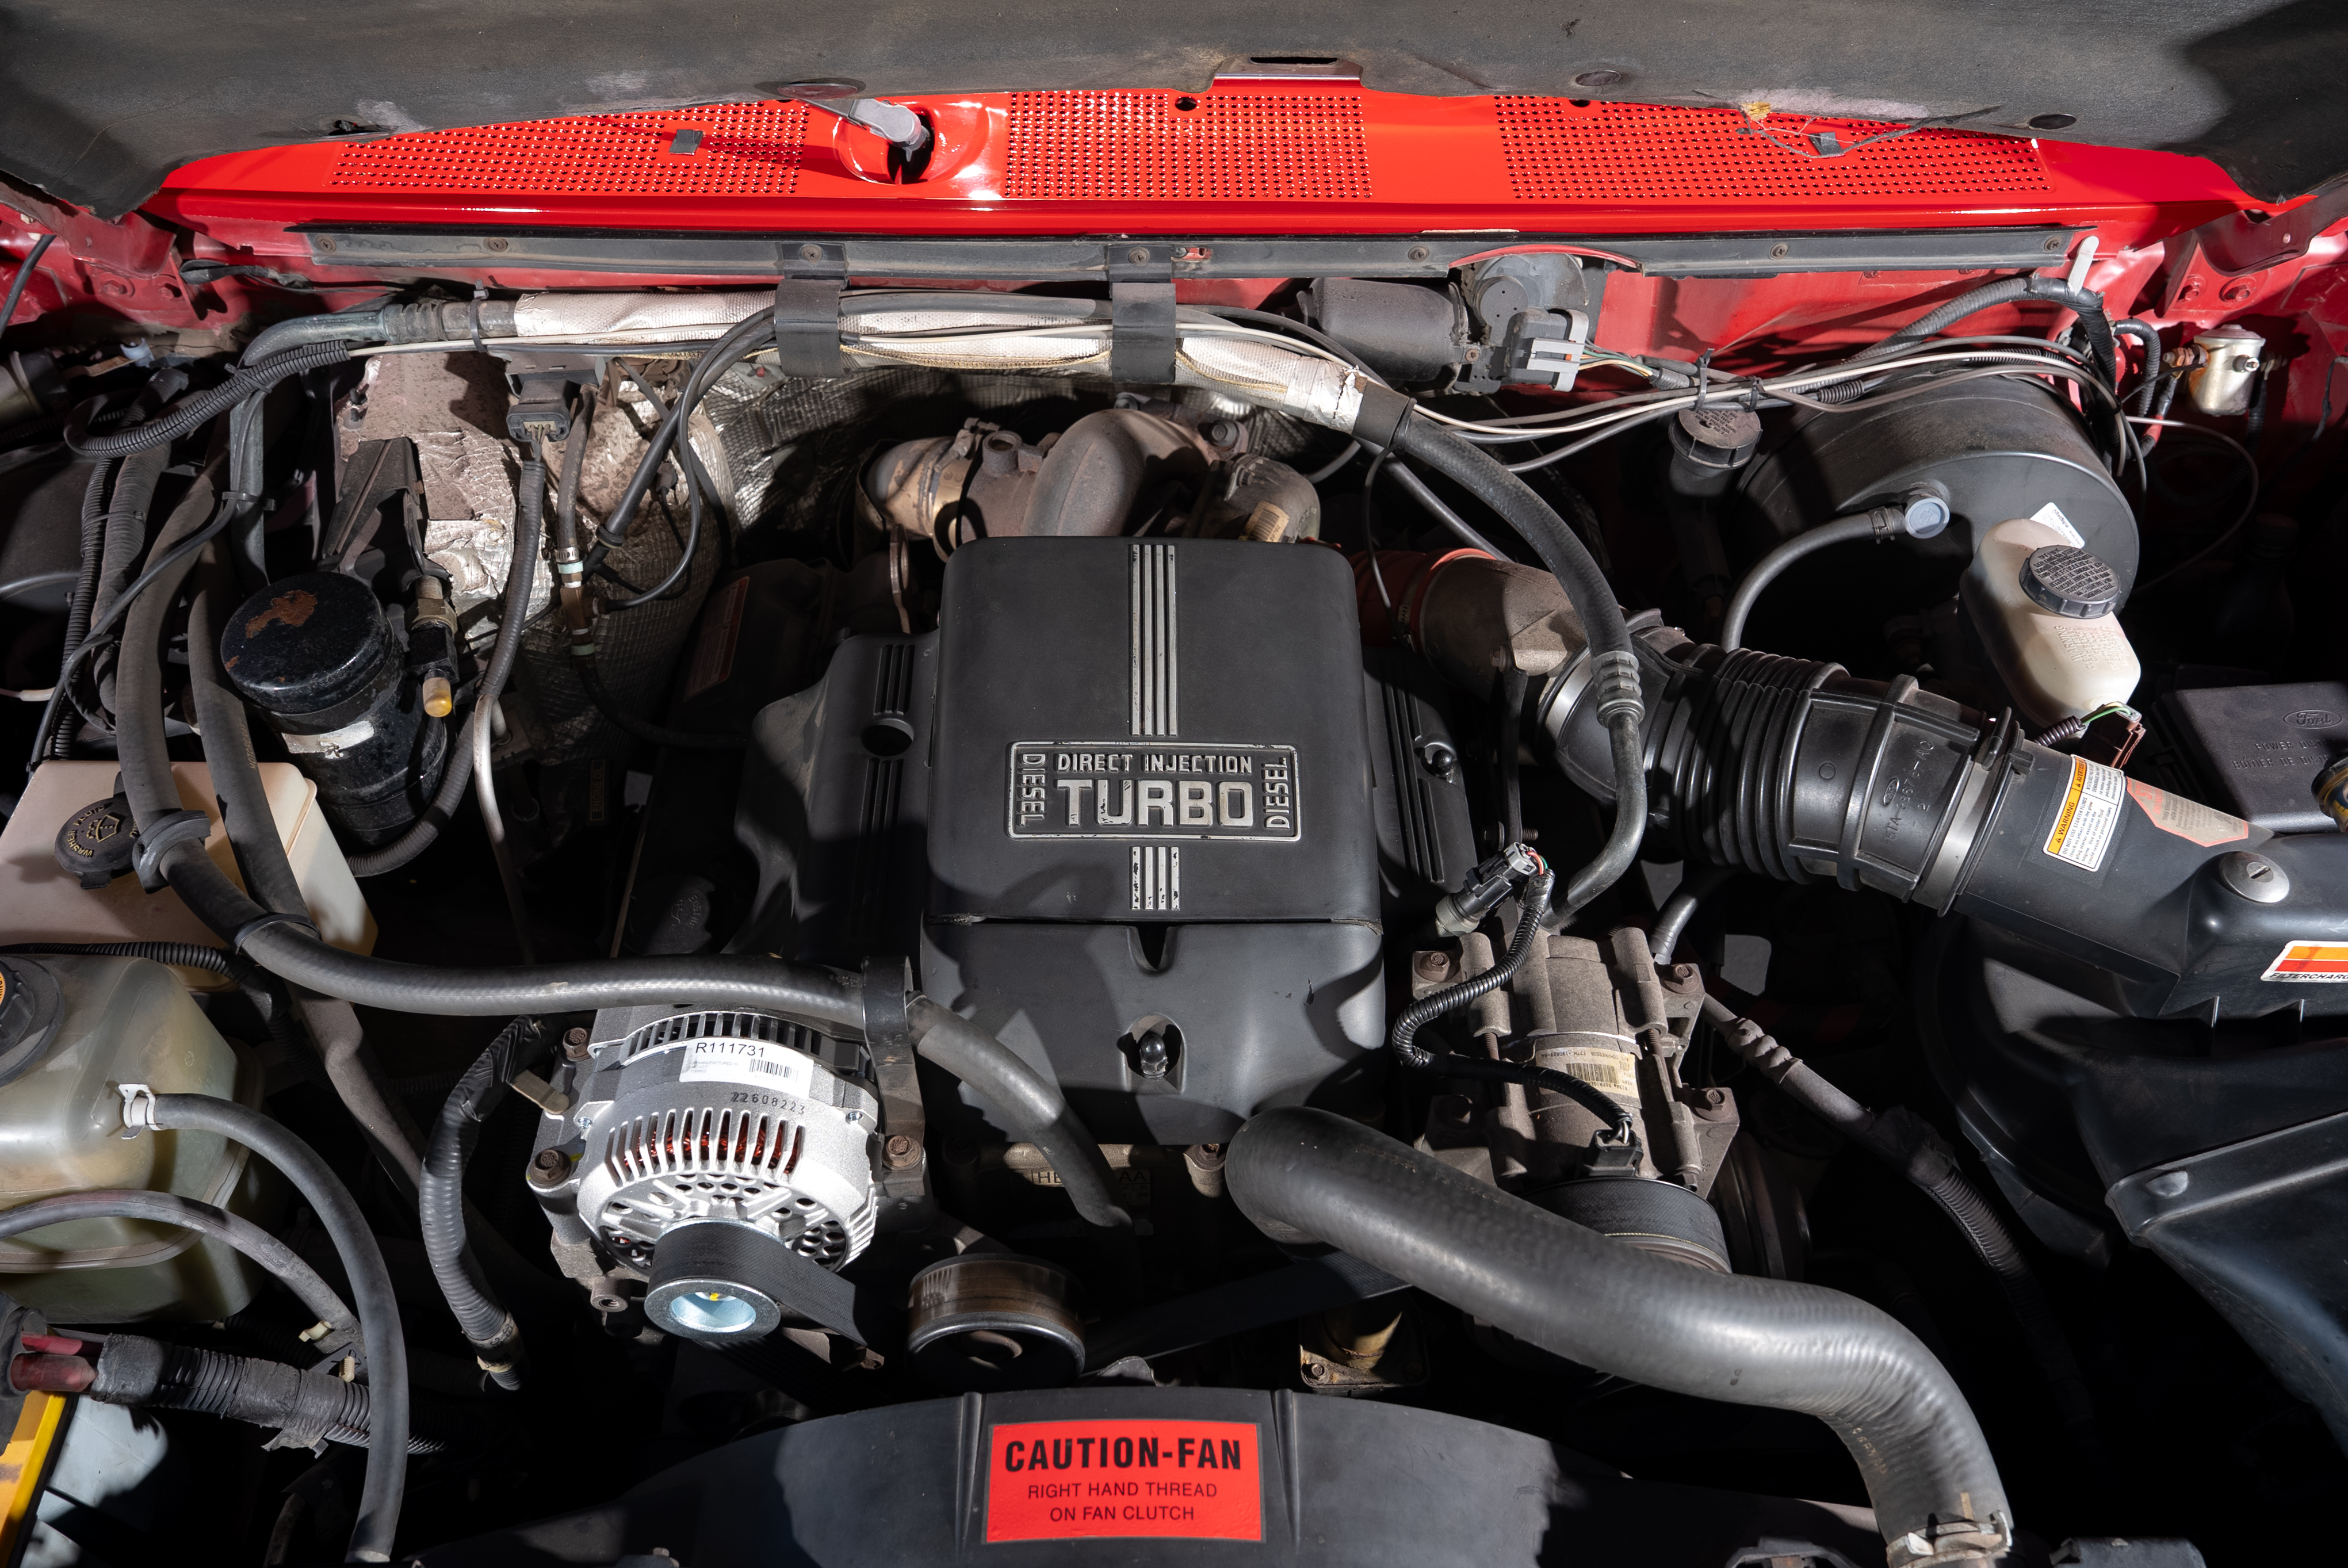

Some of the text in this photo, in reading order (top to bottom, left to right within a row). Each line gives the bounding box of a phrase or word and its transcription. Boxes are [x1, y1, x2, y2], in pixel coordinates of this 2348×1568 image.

[2053, 624, 2082, 661] WARNING
[2295, 709, 2332, 727] Ford
[2254, 741, 2293, 751] POWER
[1057, 754, 1252, 774] DIRECT INJECTION
[2279, 756, 2296, 766] DE
[592, 765, 603, 812] ENGINE OIL
[1021, 754, 1046, 826] DIESEL
[1264, 756, 1290, 828] DIESEL
[1057, 779, 1253, 827] TURBO
[1915, 799, 1931, 813] 2
[2057, 801, 2075, 835] WARNING
[2072, 809, 2083, 828] STARTER
[2093, 817, 2101, 831] starter
[67, 805, 105, 858] WASHER FLUID
[2062, 847, 2068, 855] DO
[2064, 837, 2073, 847] NOT
[2078, 835, 2088, 850] starter
[695, 1042, 764, 1057] R111731
[1005, 1437, 1241, 1472] CAUTION-FAN
[1028, 1482, 1218, 1499] RIGHT HAND THREAD
[1050, 1506, 1194, 1521] ON FAN CLUTCH
